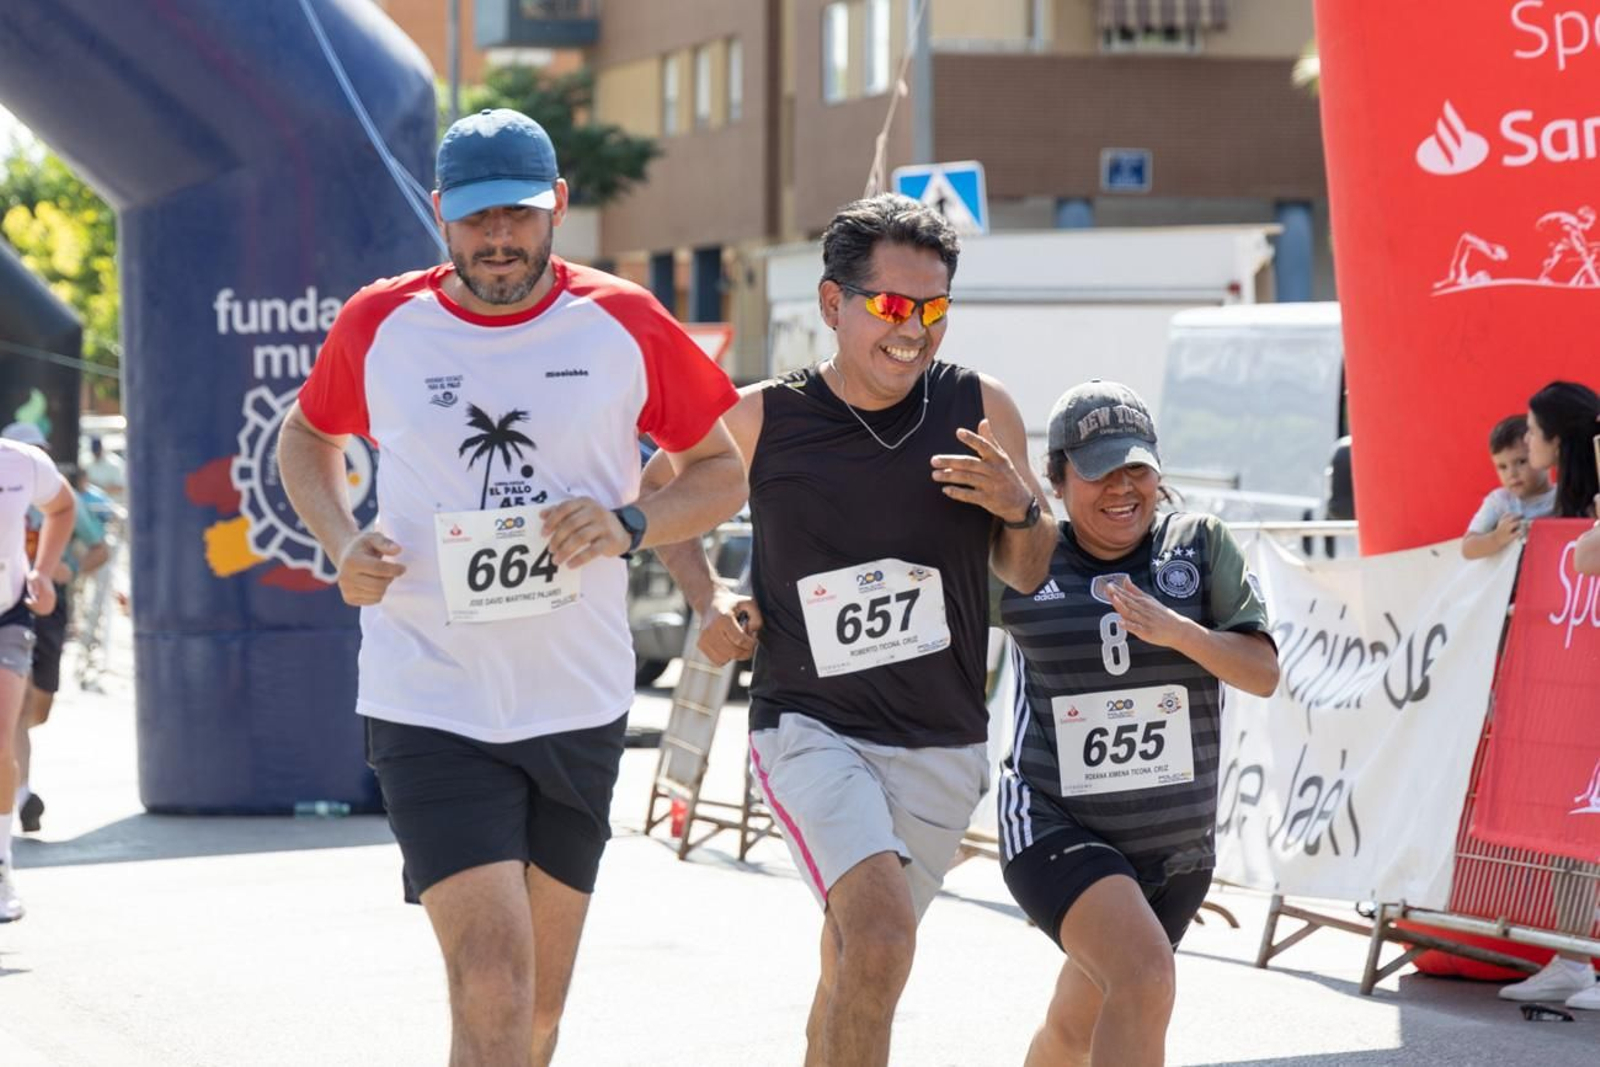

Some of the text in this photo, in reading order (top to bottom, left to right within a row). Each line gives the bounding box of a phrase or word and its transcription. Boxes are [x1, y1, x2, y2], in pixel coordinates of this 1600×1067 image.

[1078, 408, 1110, 441] NEW
[489, 485, 532, 496] EL PALO
[467, 544, 559, 593] 664
[485, 596, 504, 606] DAVID
[1033, 591, 1066, 602] adidas
[836, 588, 920, 645] 657
[902, 635, 919, 646] CRUZ
[1100, 612, 1131, 676] 8
[1083, 720, 1167, 767] 655
[1154, 765, 1169, 773] CRUZ
